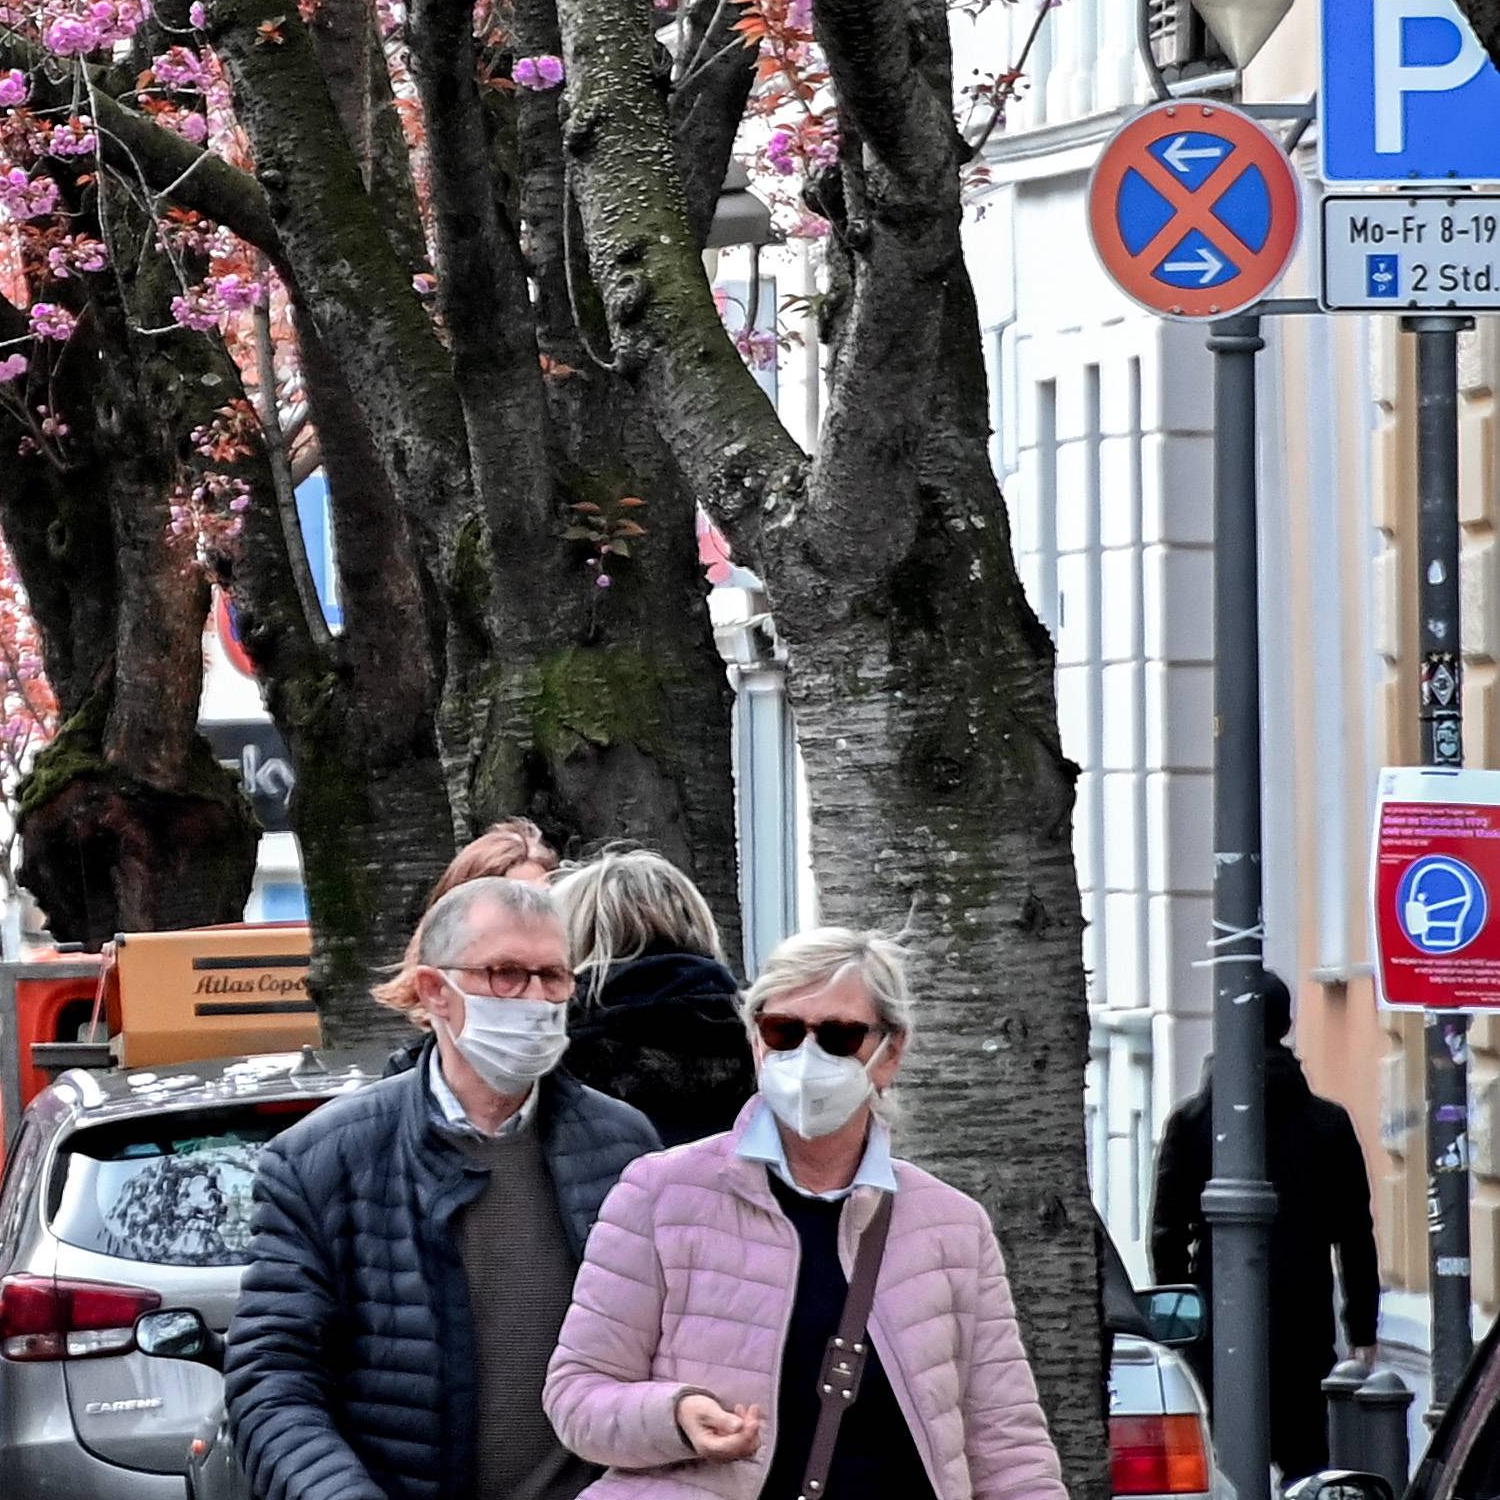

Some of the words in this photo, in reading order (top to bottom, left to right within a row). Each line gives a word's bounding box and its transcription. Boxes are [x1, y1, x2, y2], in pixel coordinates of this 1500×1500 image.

[1349, 216, 1426, 244] Mo-Fr
[1440, 216, 1497, 244] 8-19
[1411, 264, 1428, 292] 2
[1439, 264, 1500, 292] Std.
[193, 974, 255, 995] Atlas
